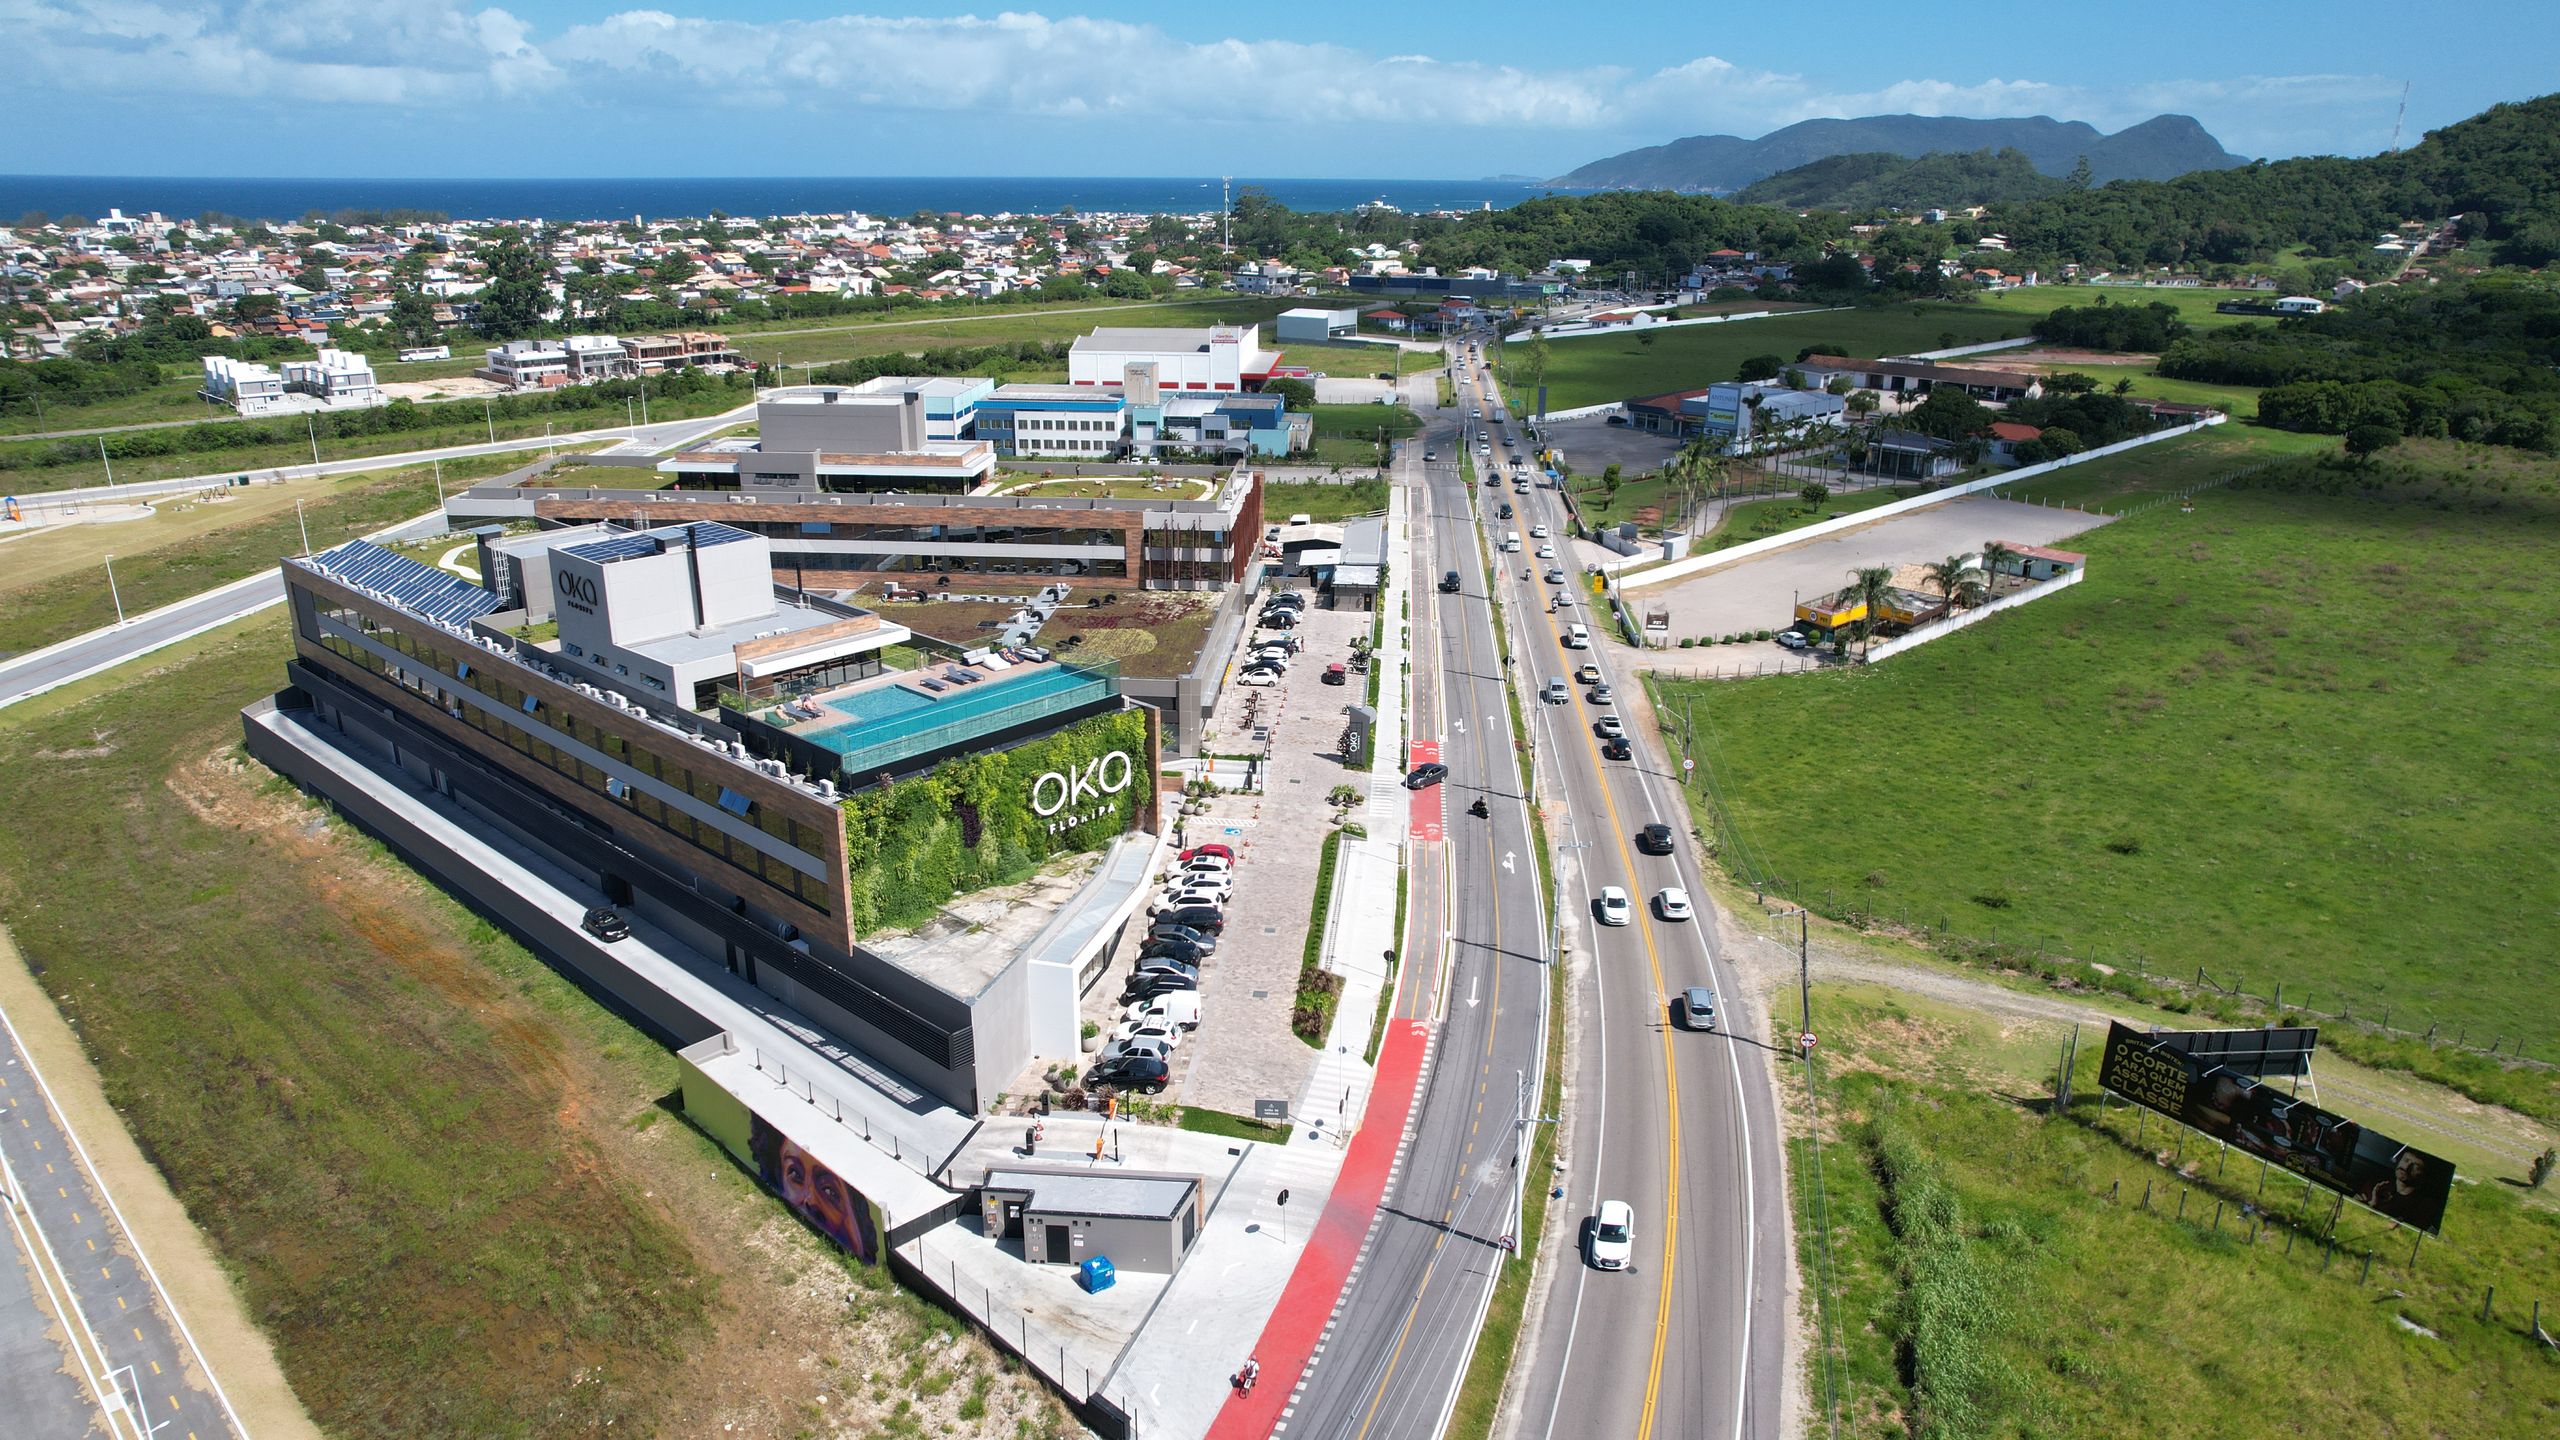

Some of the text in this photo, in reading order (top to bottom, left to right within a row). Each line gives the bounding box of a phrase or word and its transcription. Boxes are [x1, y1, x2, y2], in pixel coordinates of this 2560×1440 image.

[2114, 1054, 2186, 1093] PARA QUEM
[2116, 1044, 2189, 1083] O CORTE
[2110, 1075, 2182, 1115] CLASSE
[2112, 1065, 2184, 1103] ASSA COM
